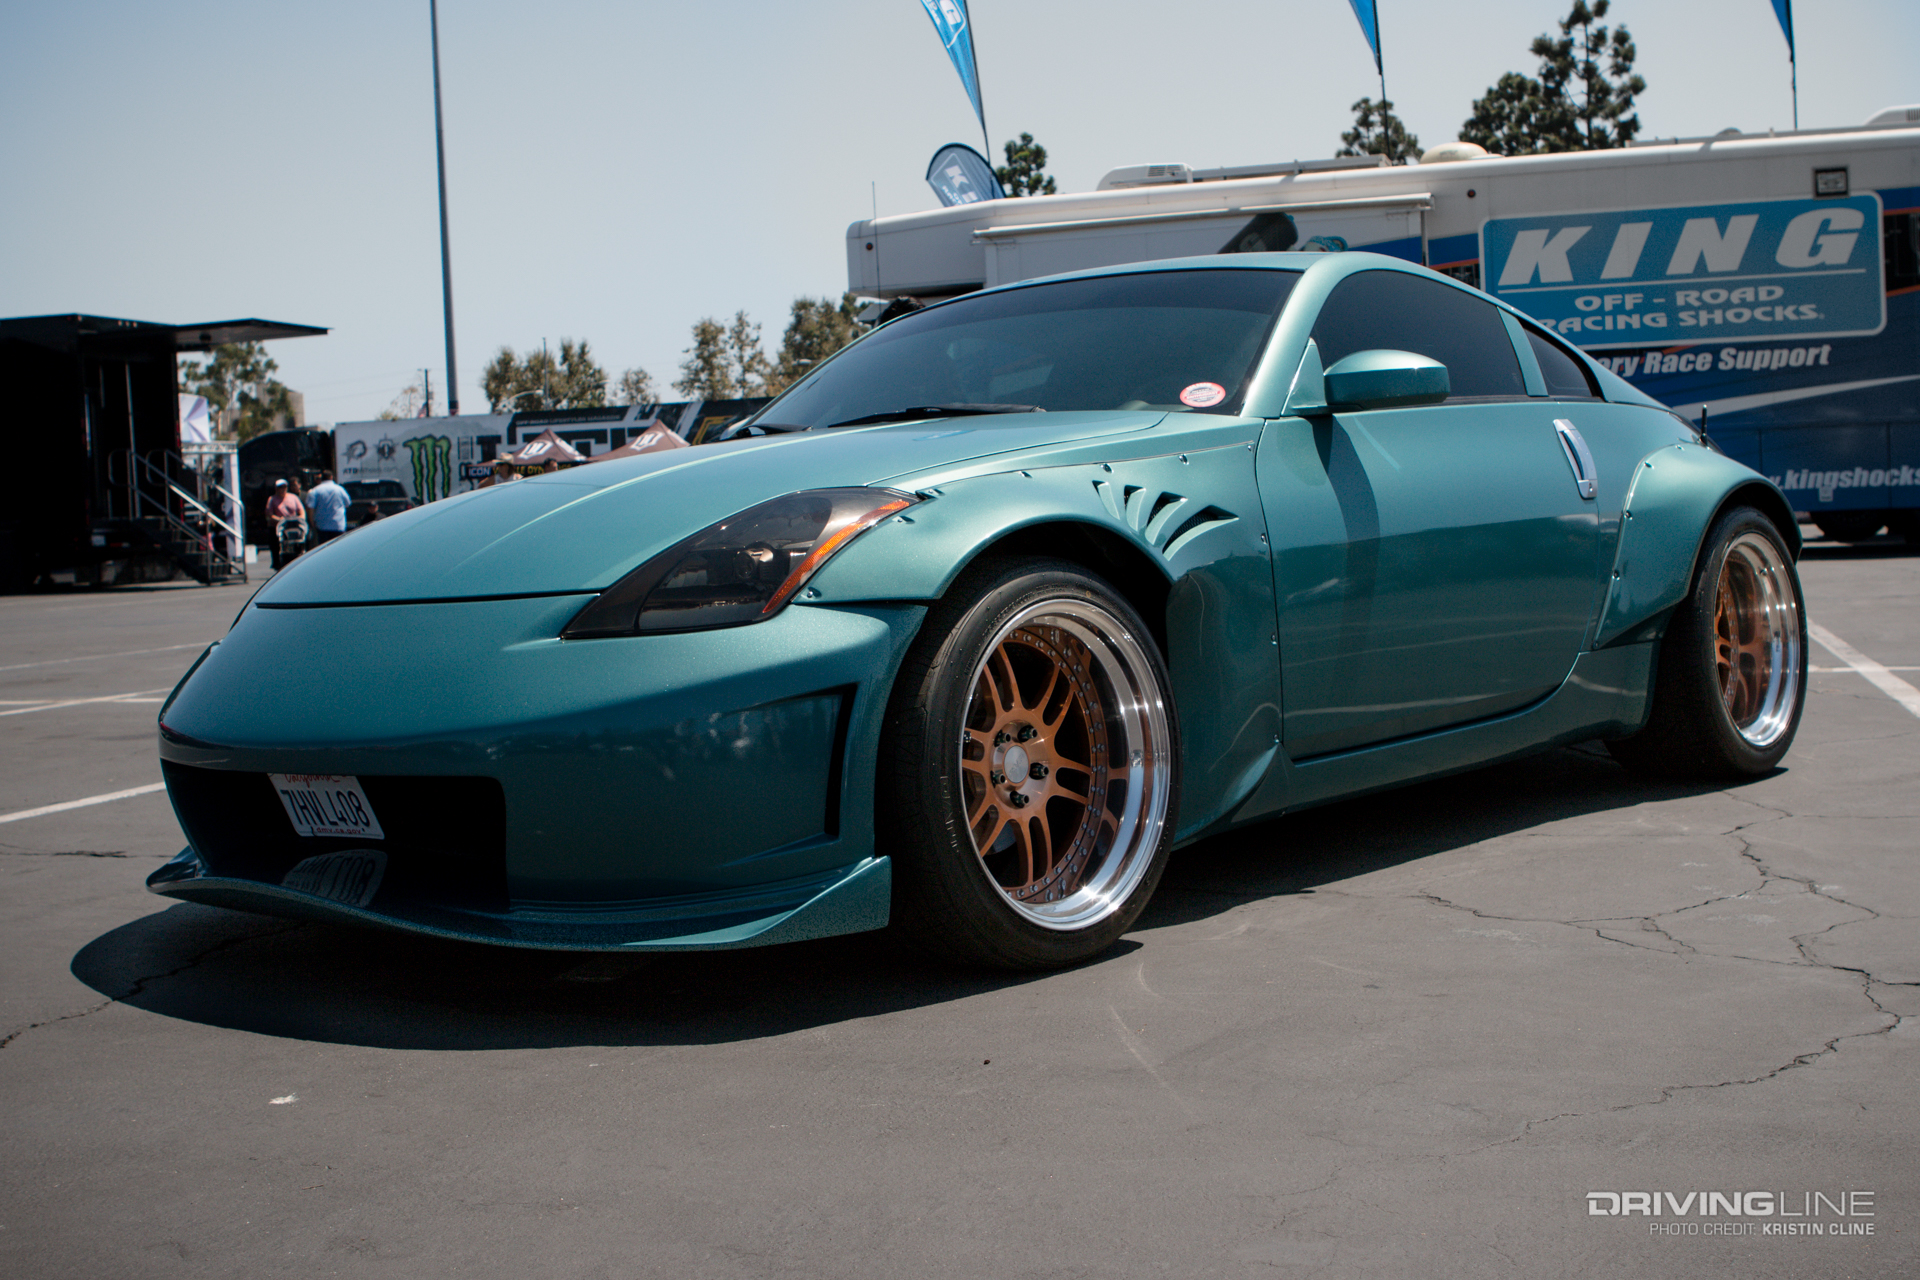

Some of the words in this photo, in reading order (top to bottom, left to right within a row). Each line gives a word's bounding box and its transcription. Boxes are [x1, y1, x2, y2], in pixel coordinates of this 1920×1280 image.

[1498, 207, 1865, 286] KING
[1574, 293, 1644, 312] OFF
[1676, 285, 1784, 307] ROAD
[1643, 351, 1714, 374] Race
[1718, 344, 1832, 371] Support
[468, 467, 491, 477] ICON
[280, 789, 371, 828] 7HVL408
